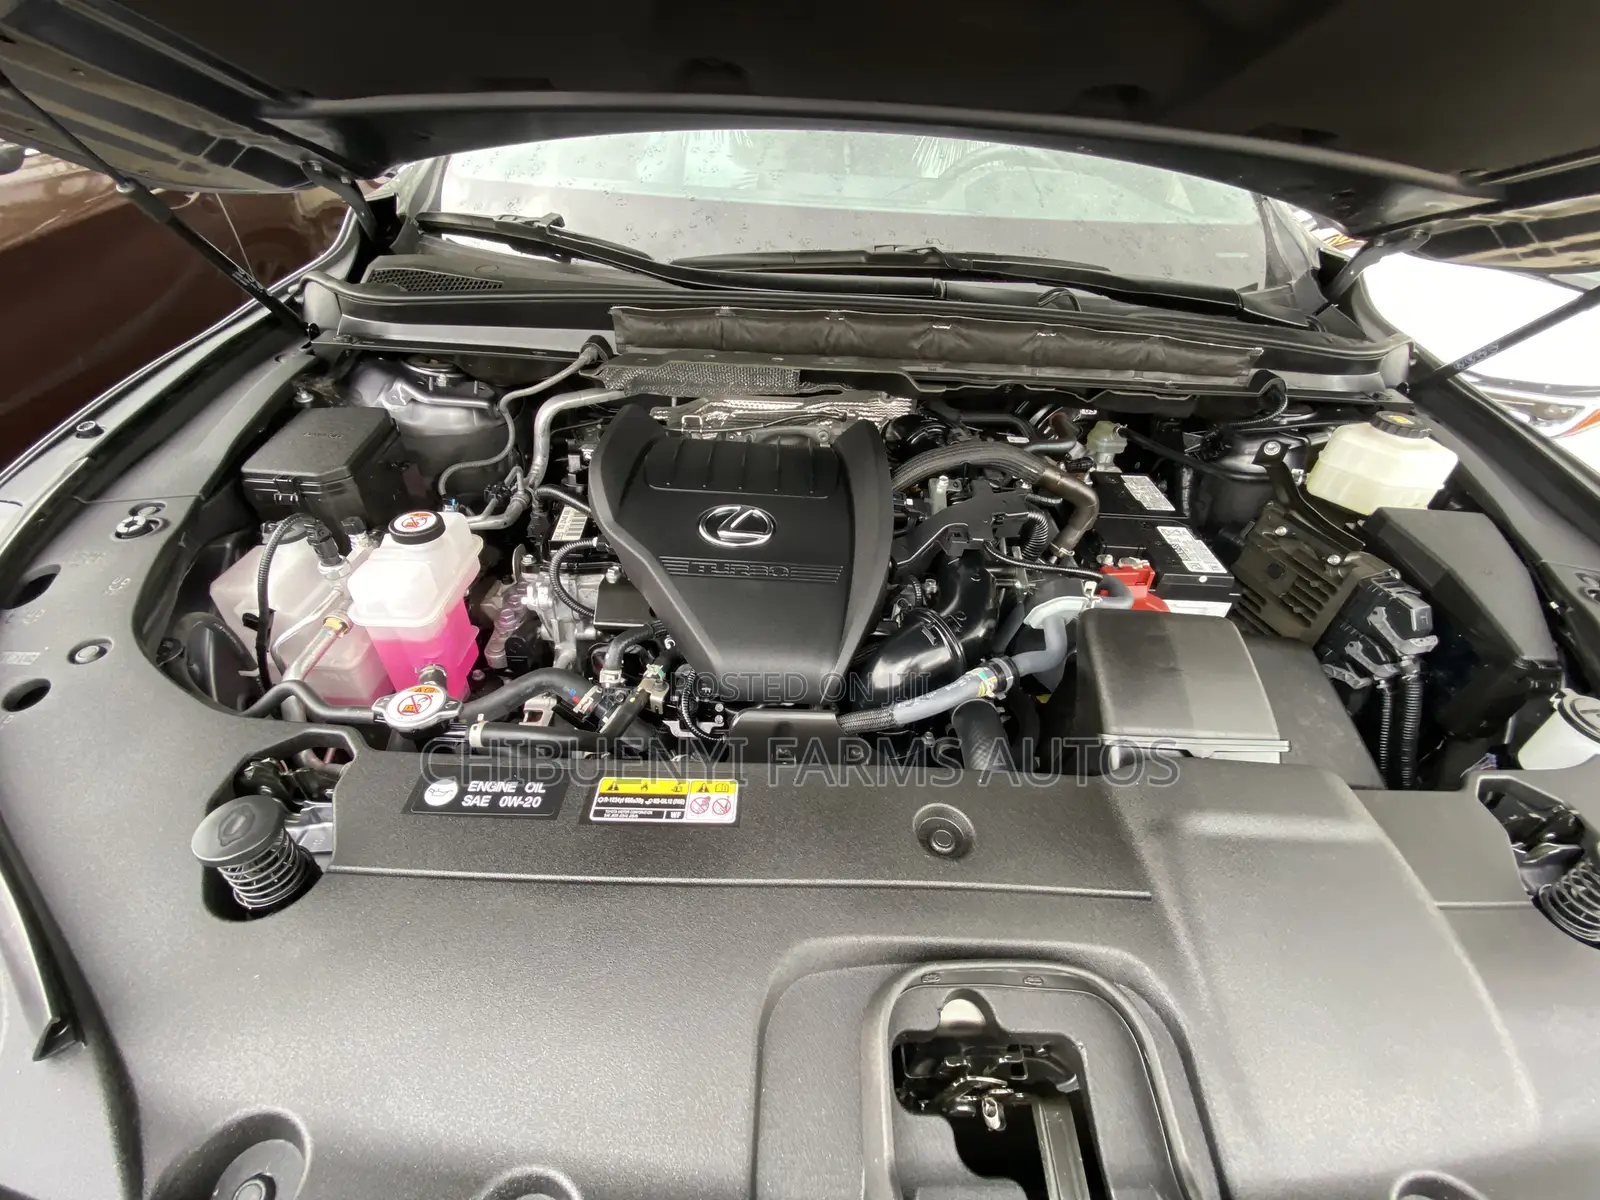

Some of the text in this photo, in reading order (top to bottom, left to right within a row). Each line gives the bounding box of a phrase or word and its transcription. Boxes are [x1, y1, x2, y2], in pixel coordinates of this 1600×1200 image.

[691, 561, 790, 577] TURBO
[467, 780, 547, 794] ENGINE OIL
[461, 795, 542, 808] SAE 0W-20
